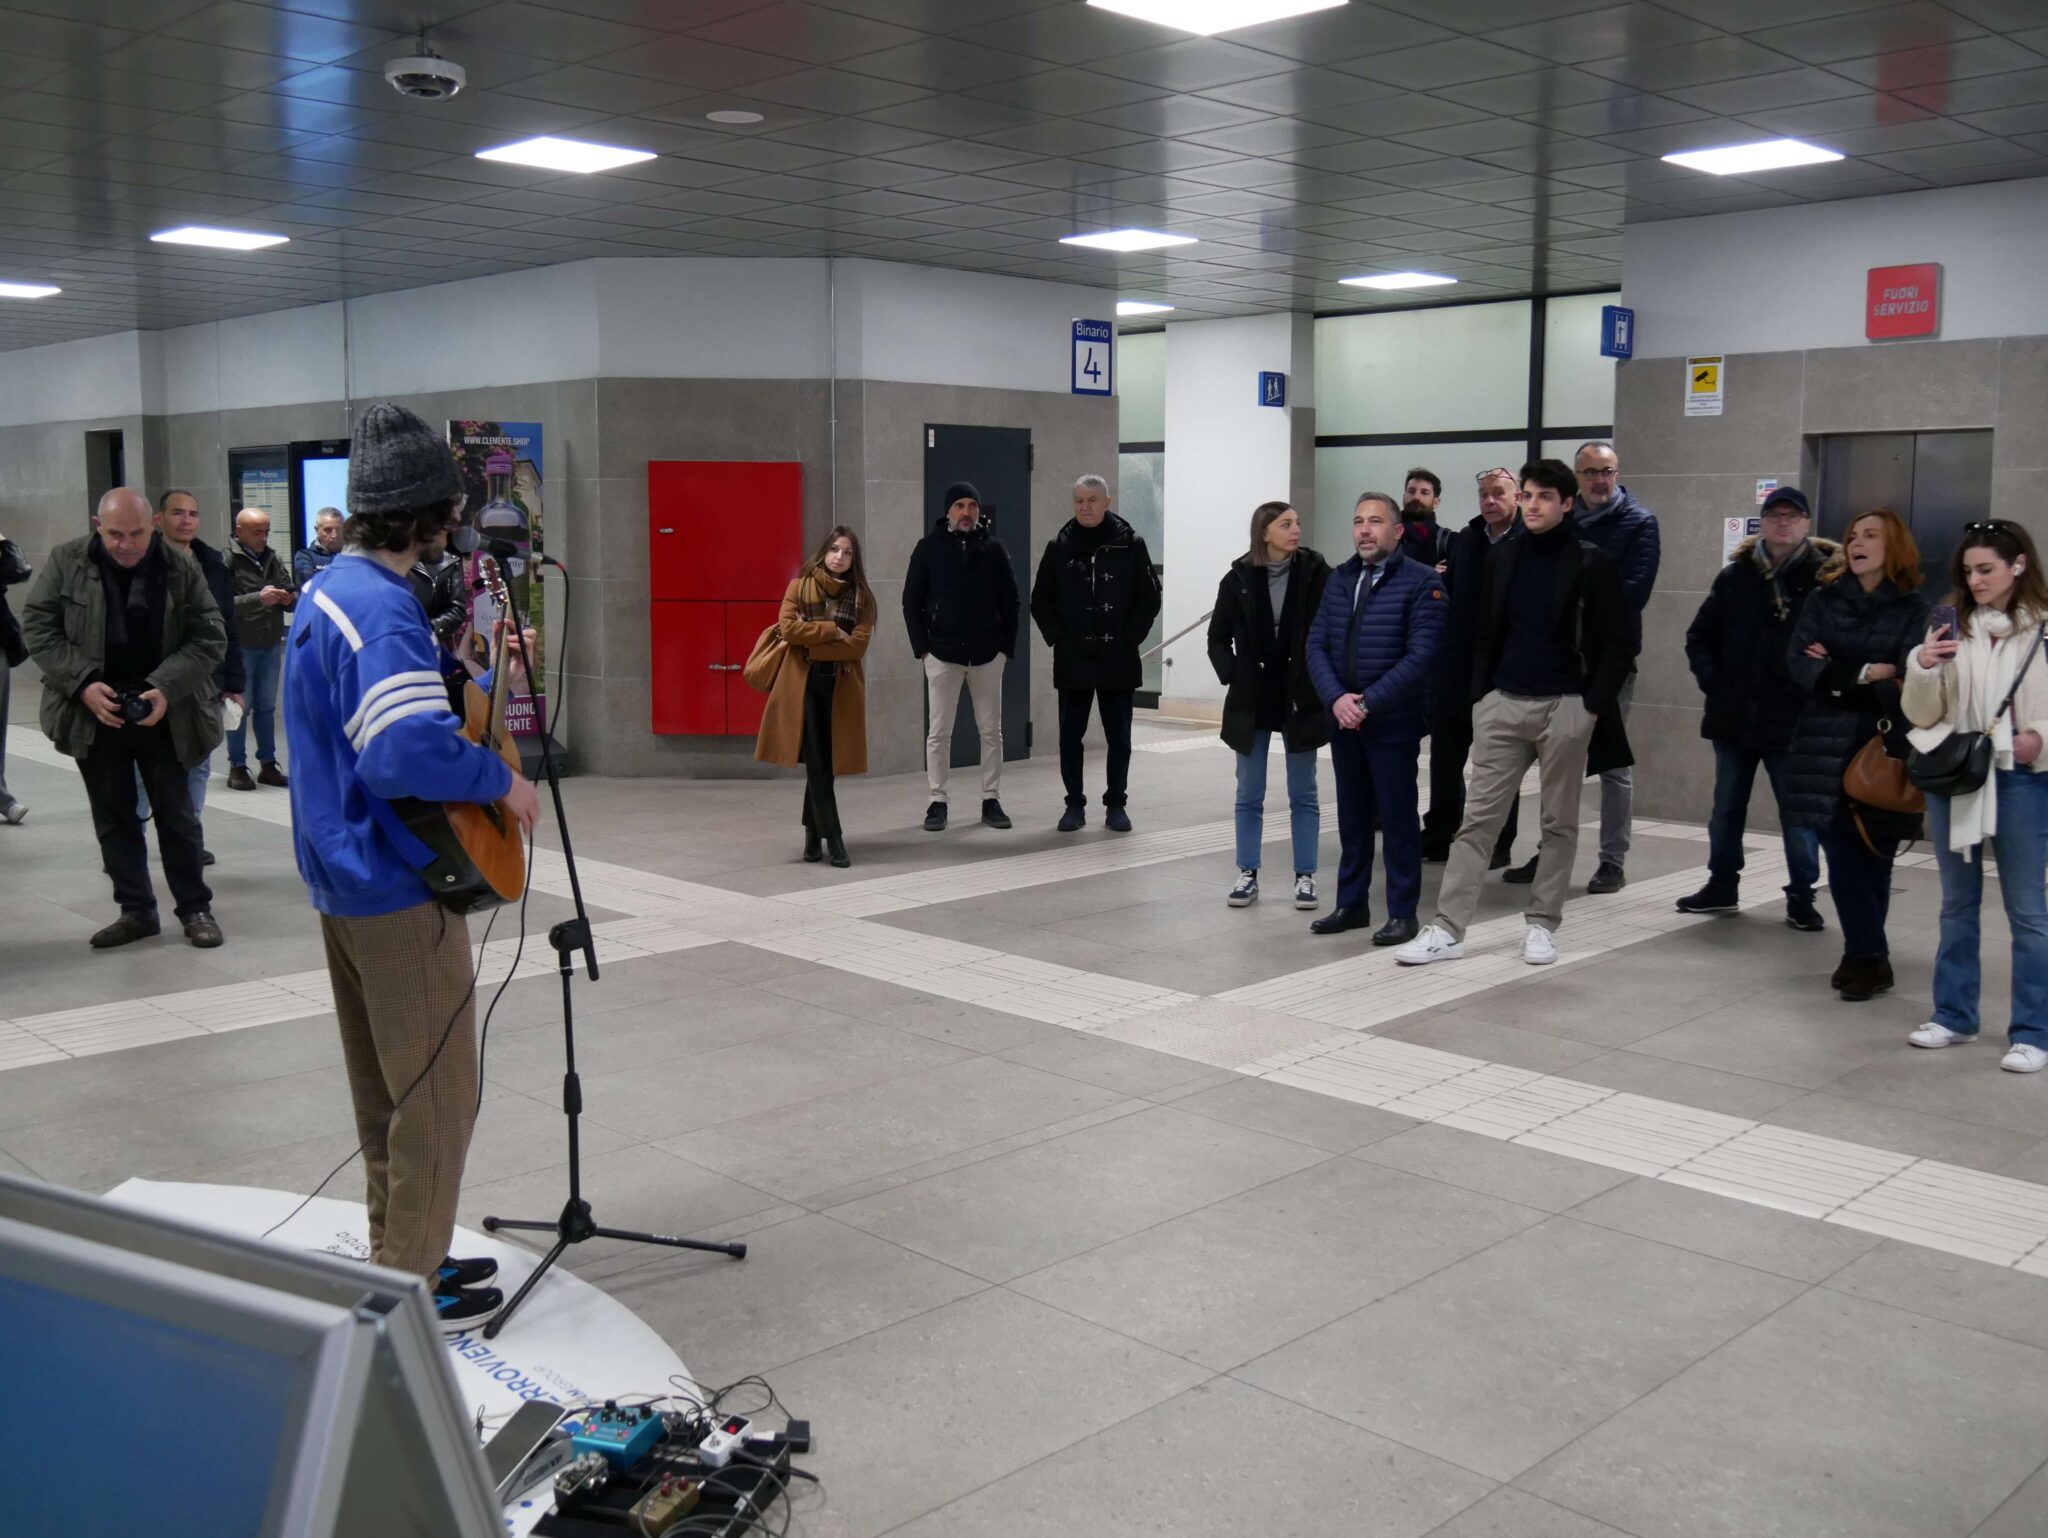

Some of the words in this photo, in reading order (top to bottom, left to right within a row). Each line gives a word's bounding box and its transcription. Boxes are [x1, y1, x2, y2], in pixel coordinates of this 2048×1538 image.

[1884, 286, 1919, 300] FUORI
[1873, 300, 1929, 317] SERVIZIO
[1076, 322, 1109, 338] Binario
[1083, 347, 1101, 383] 4
[463, 436, 530, 446] WWW.CLEMENTE.SHOP
